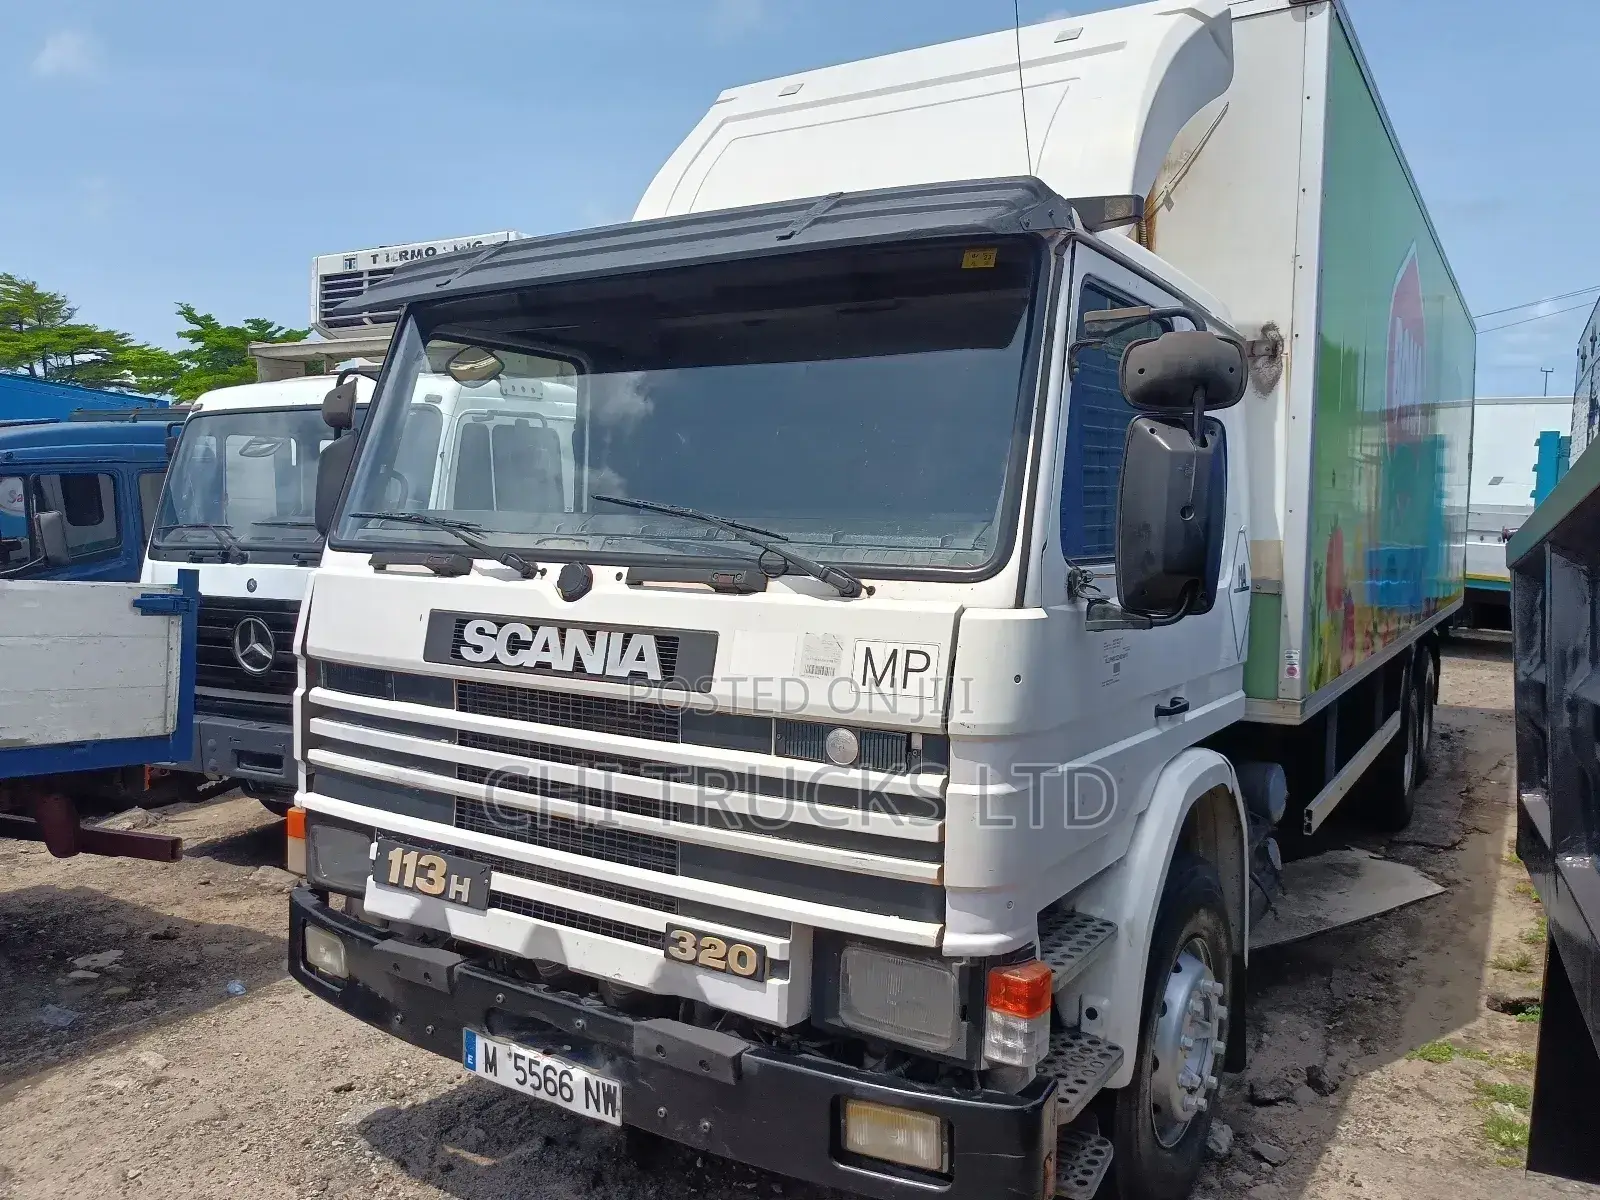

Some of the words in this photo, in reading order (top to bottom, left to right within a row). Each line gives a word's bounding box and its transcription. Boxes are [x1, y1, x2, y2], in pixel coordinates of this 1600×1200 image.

[460, 619, 663, 681] SCANIA
[861, 646, 931, 689] MP
[388, 847, 447, 895] 113
[448, 874, 471, 903] H
[668, 929, 757, 976] 320
[467, 1054, 474, 1065] E
[484, 1042, 498, 1077] M
[513, 1052, 574, 1103] 5566
[584, 1076, 618, 1118] NW
